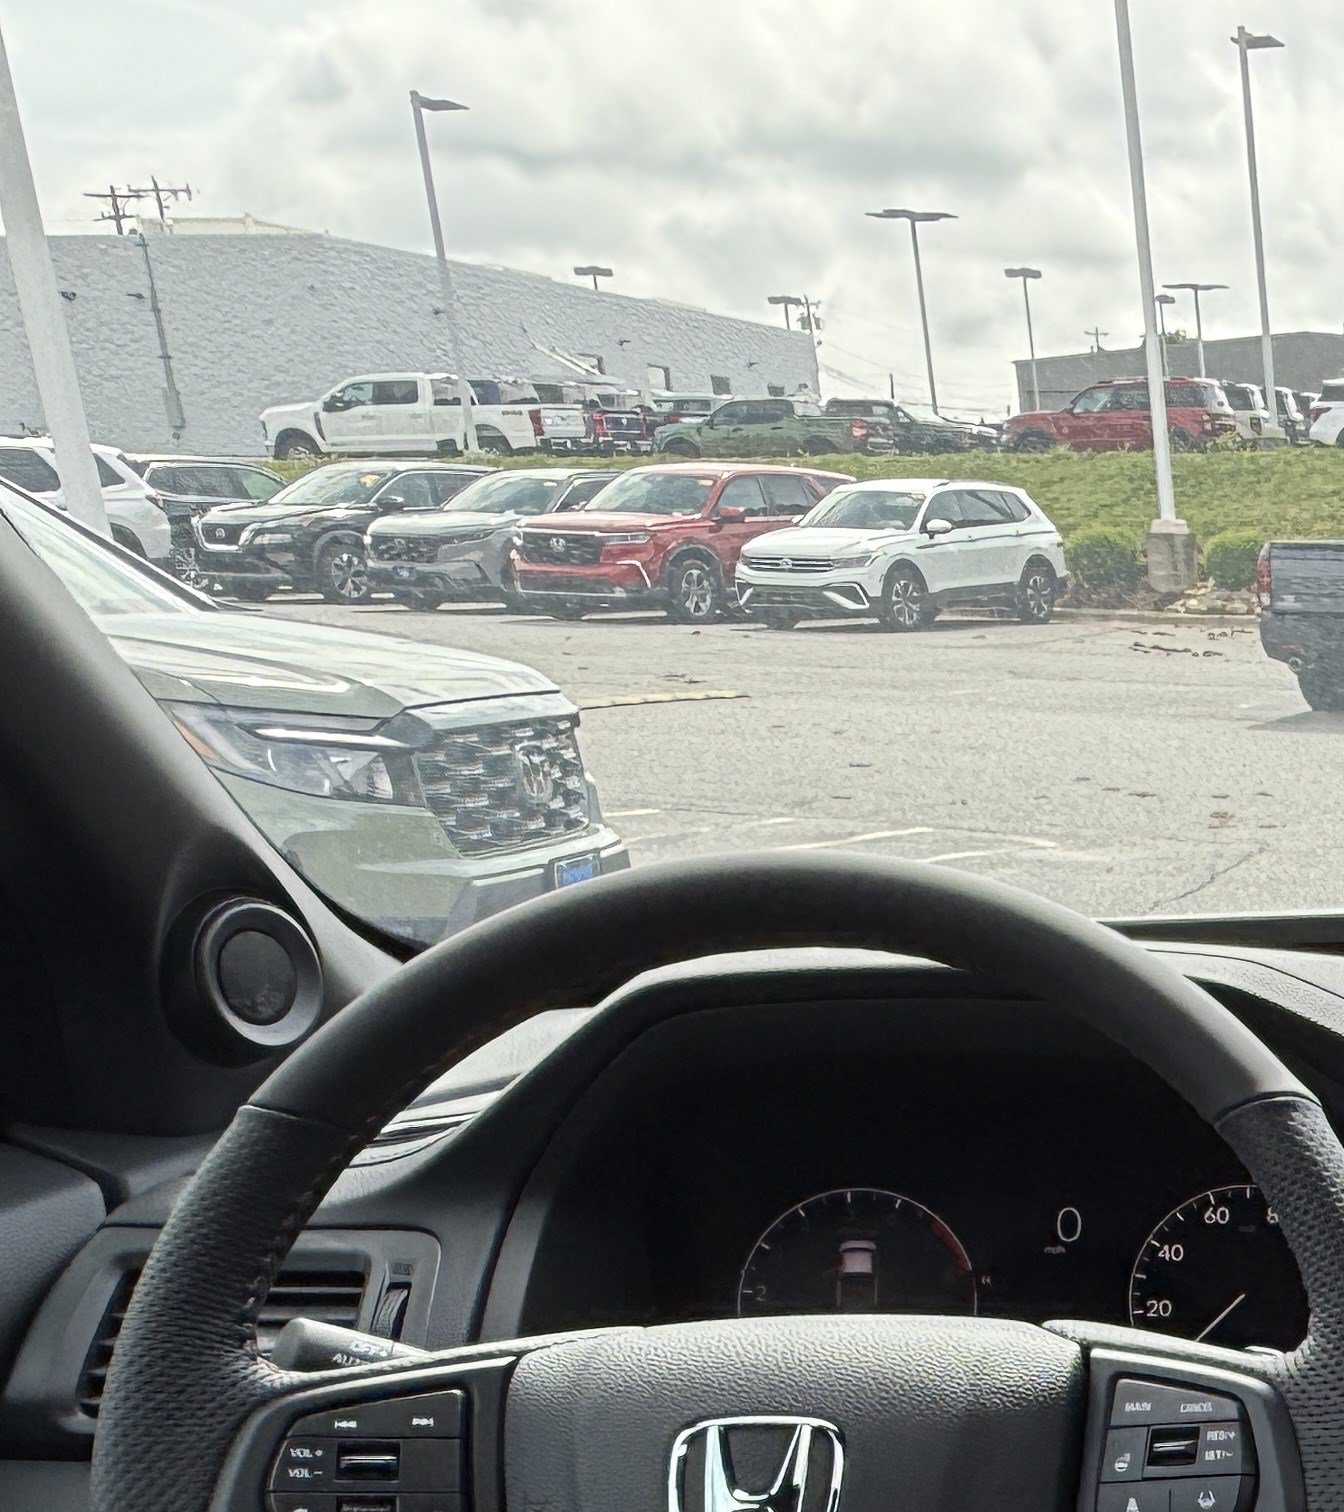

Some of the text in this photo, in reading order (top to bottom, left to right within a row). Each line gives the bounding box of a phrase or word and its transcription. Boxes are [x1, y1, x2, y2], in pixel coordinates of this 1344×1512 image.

[1057, 1207, 1082, 1242] 0
[1204, 1206, 1230, 1225] 60
[1158, 1244, 1184, 1262] 40
[1146, 1300, 1173, 1317] 20
